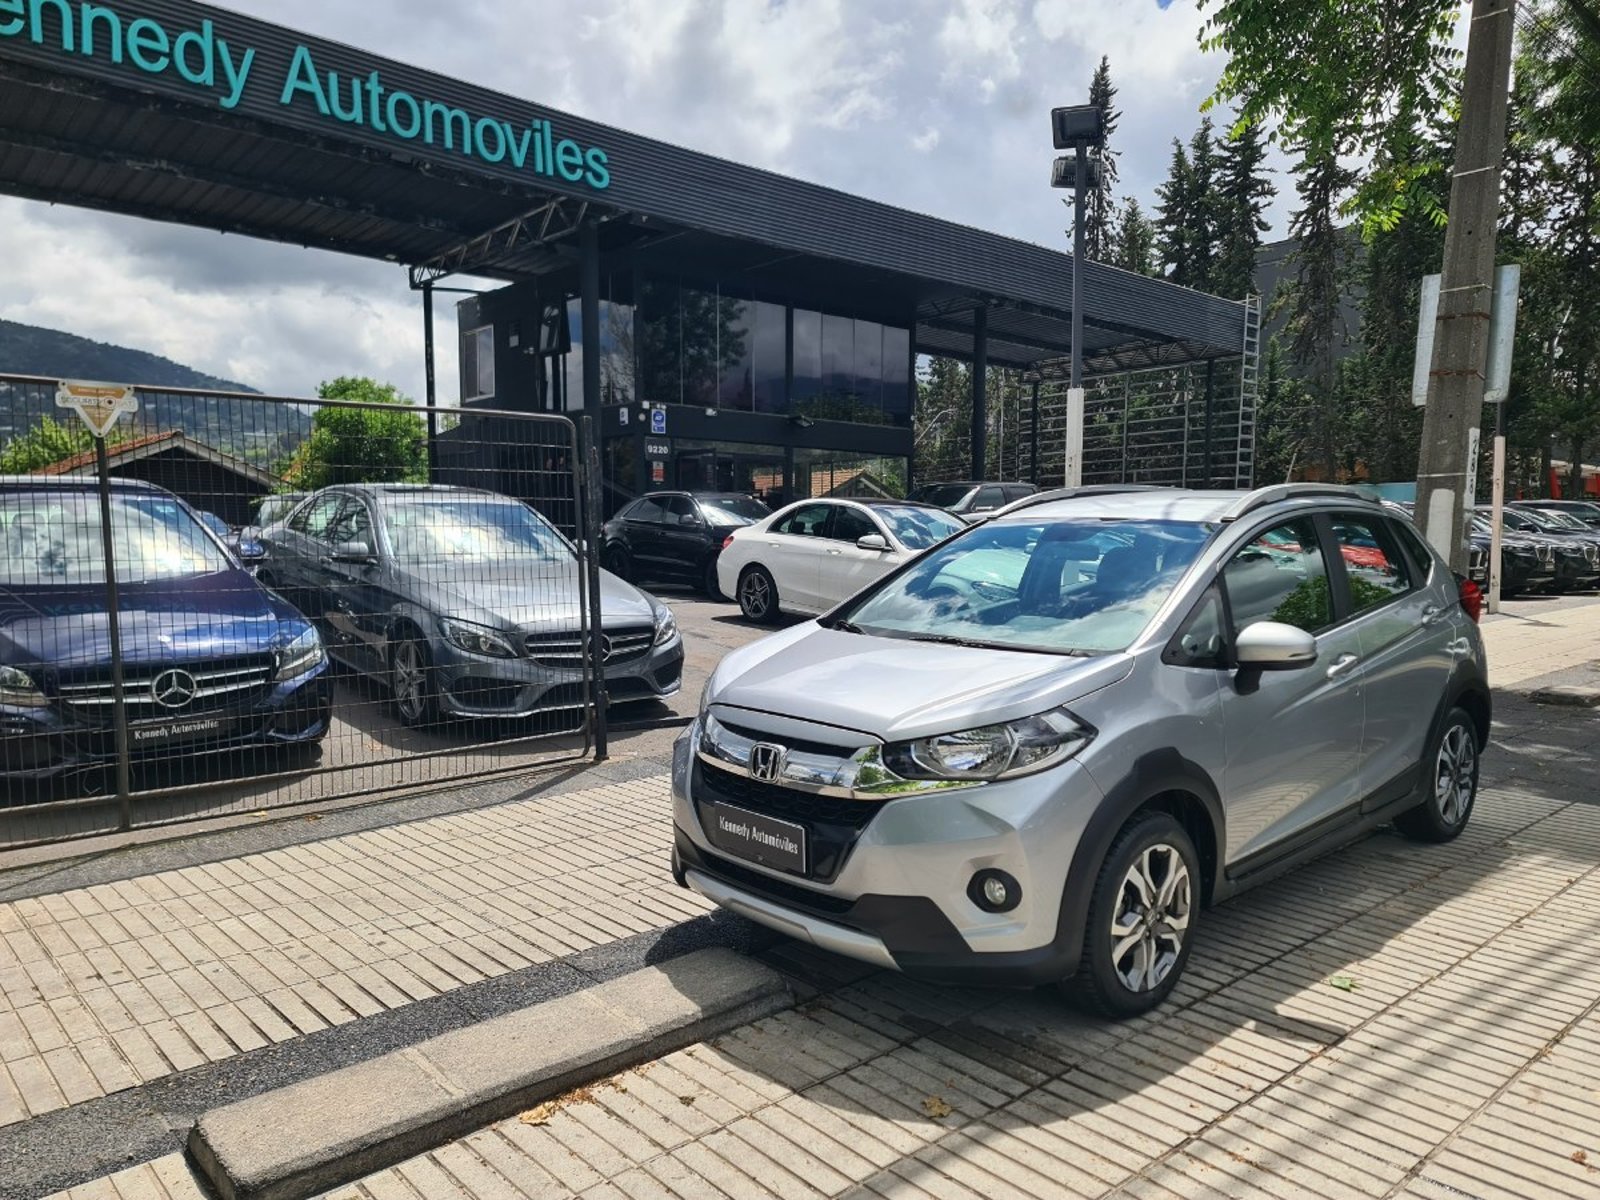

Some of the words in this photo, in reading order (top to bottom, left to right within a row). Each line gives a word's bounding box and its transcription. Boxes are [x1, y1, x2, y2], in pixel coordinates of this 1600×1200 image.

[279, 46, 611, 190] Automoviles
[647, 445, 668, 454] 9220
[134, 726, 168, 740] Kennedy
[719, 815, 750, 841] Kennedy
[751, 826, 798, 854] Automóviles
